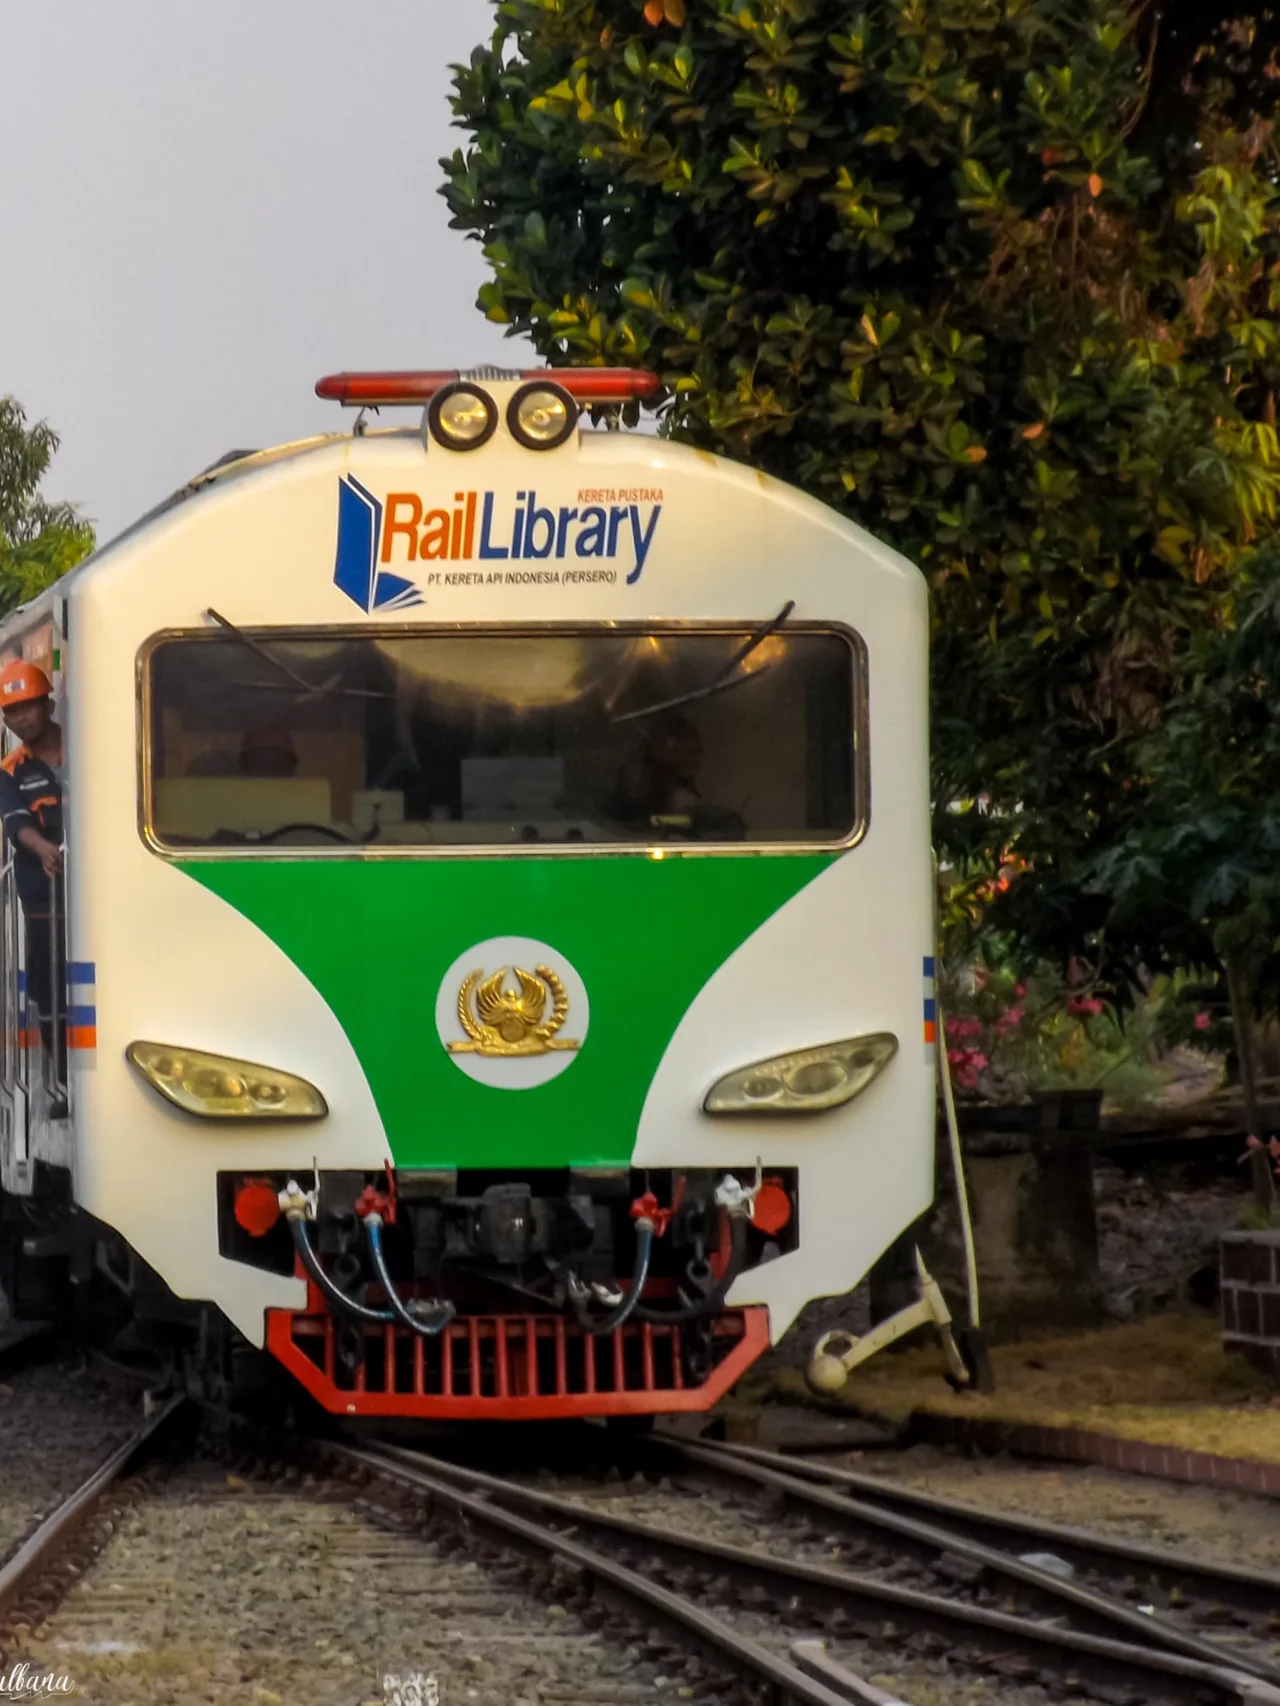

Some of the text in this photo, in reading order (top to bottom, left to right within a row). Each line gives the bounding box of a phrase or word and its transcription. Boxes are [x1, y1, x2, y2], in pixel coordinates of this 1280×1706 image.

[577, 487, 664, 503] KERETA PUSTAKA
[427, 570, 617, 585] PT. KERETA API INDONESIA (PERSERO)
